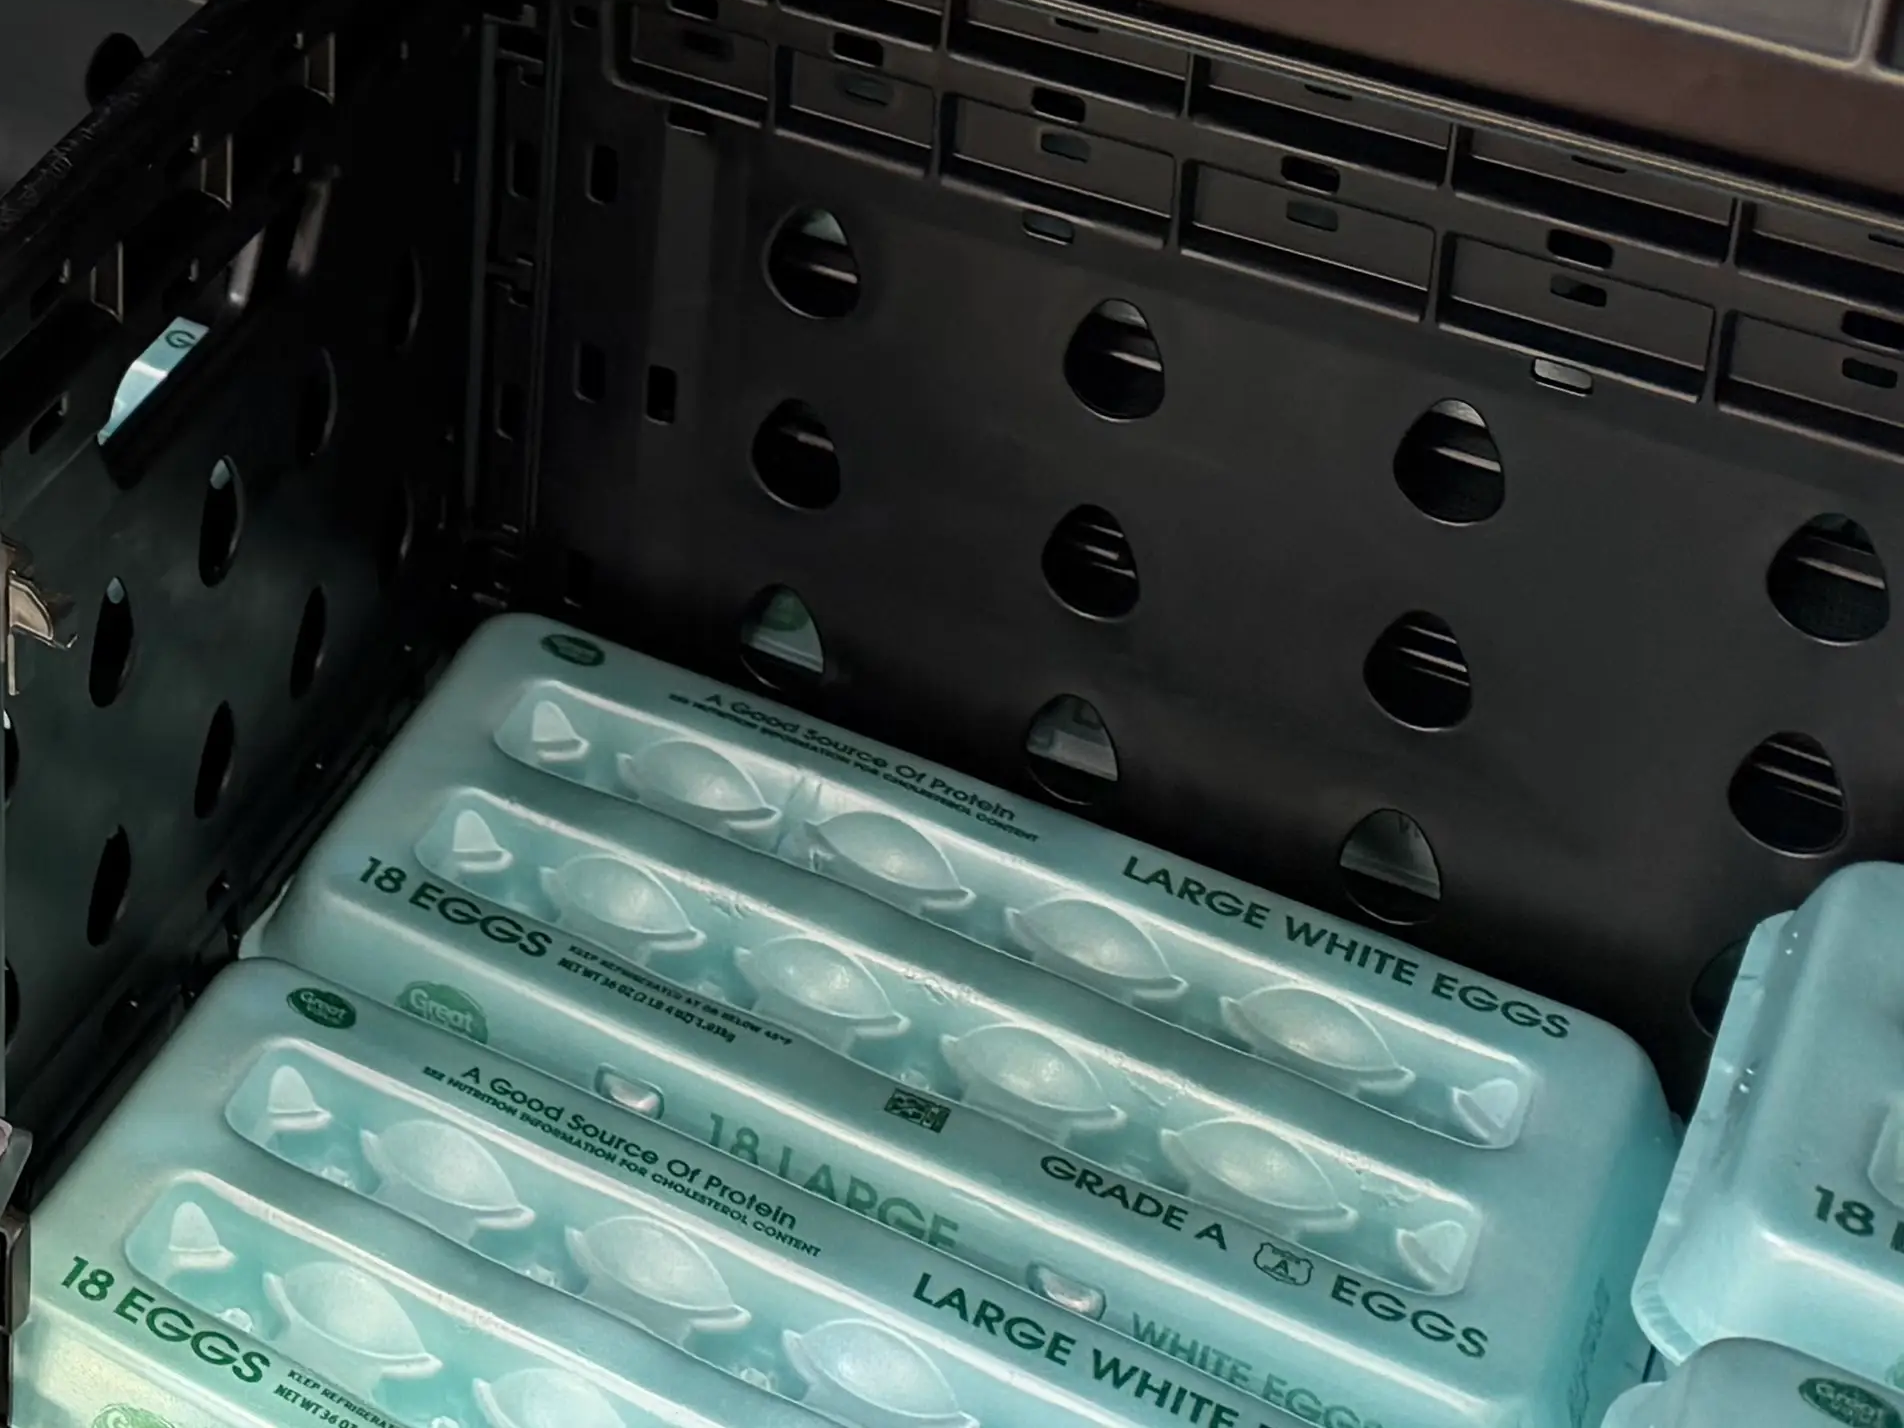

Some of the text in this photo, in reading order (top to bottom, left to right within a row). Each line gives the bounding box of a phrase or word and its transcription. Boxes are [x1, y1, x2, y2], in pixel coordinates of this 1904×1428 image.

[1122, 856, 1571, 1042] LARGE WHITE EGGS
[448, 1073, 518, 1116] NUTRITION
[519, 1110, 617, 1163] INFORMATION
[618, 1157, 648, 1179] FOR
[649, 1171, 749, 1225] CHOLESTEROL
[751, 1220, 821, 1257] CONTENT
[460, 1067, 798, 1230] A Good Source Of Protein
[60, 1255, 271, 1385] 18 EGGS
[1038, 1154, 1491, 1361] GRADE A EGGS
[913, 1272, 1240, 1428] LARGE WHITE
